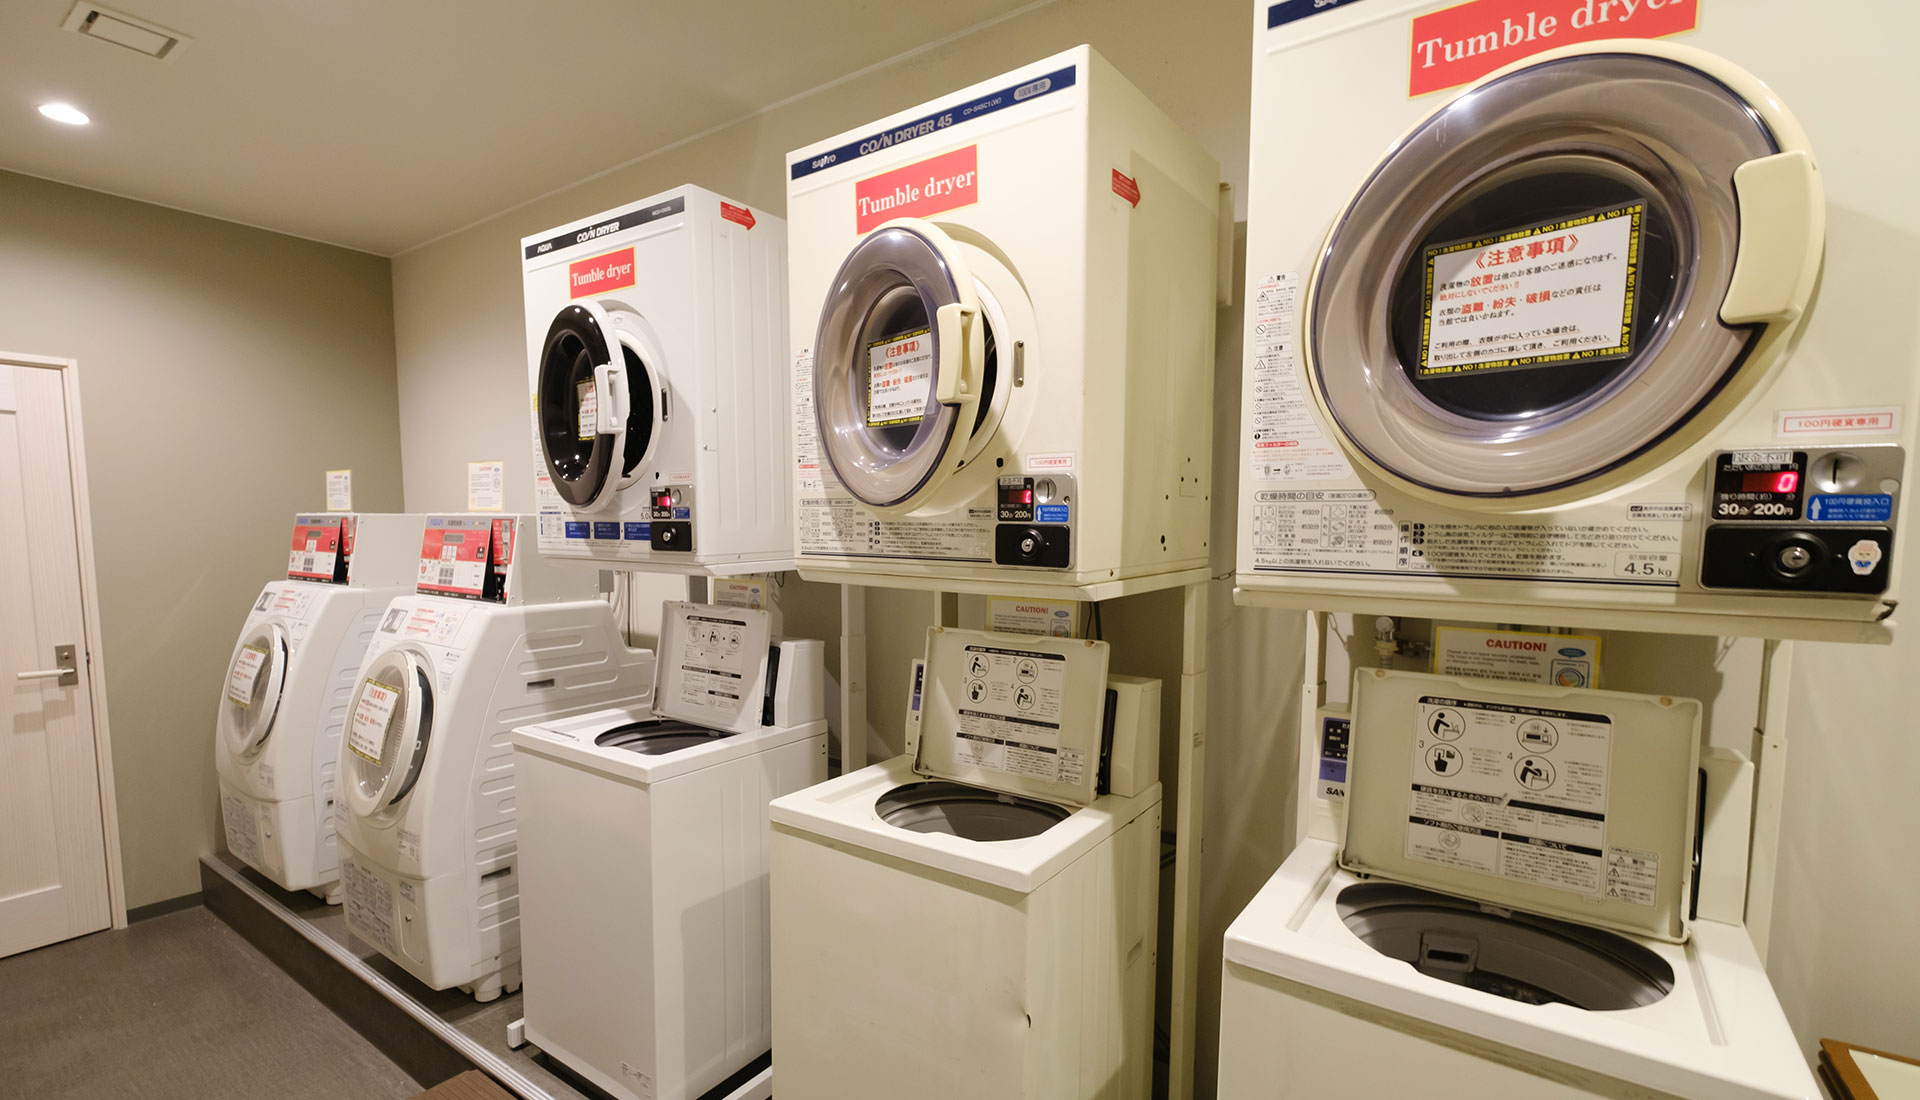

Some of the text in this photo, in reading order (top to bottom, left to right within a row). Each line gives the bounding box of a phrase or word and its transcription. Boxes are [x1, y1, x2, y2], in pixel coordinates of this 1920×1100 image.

[1418, 13, 1557, 69] Tumble
[812, 113, 952, 170] SANYO COIN DRYER 45
[858, 170, 976, 216] Tumble dryer
[537, 242, 552, 253] AQUA
[596, 221, 620, 236] DRYER
[1475, 234, 1579, 269] 《注意事項》
[572, 262, 632, 287] Tumble dryer
[1777, 473, 1798, 492] 0
[1624, 562, 1672, 577] 4.5 kg
[1016, 606, 1048, 614] CAUTION!
[1486, 638, 1547, 652] CAUTION!
[1510, 716, 1516, 724] 2
[1418, 740, 1513, 760] 3 4
